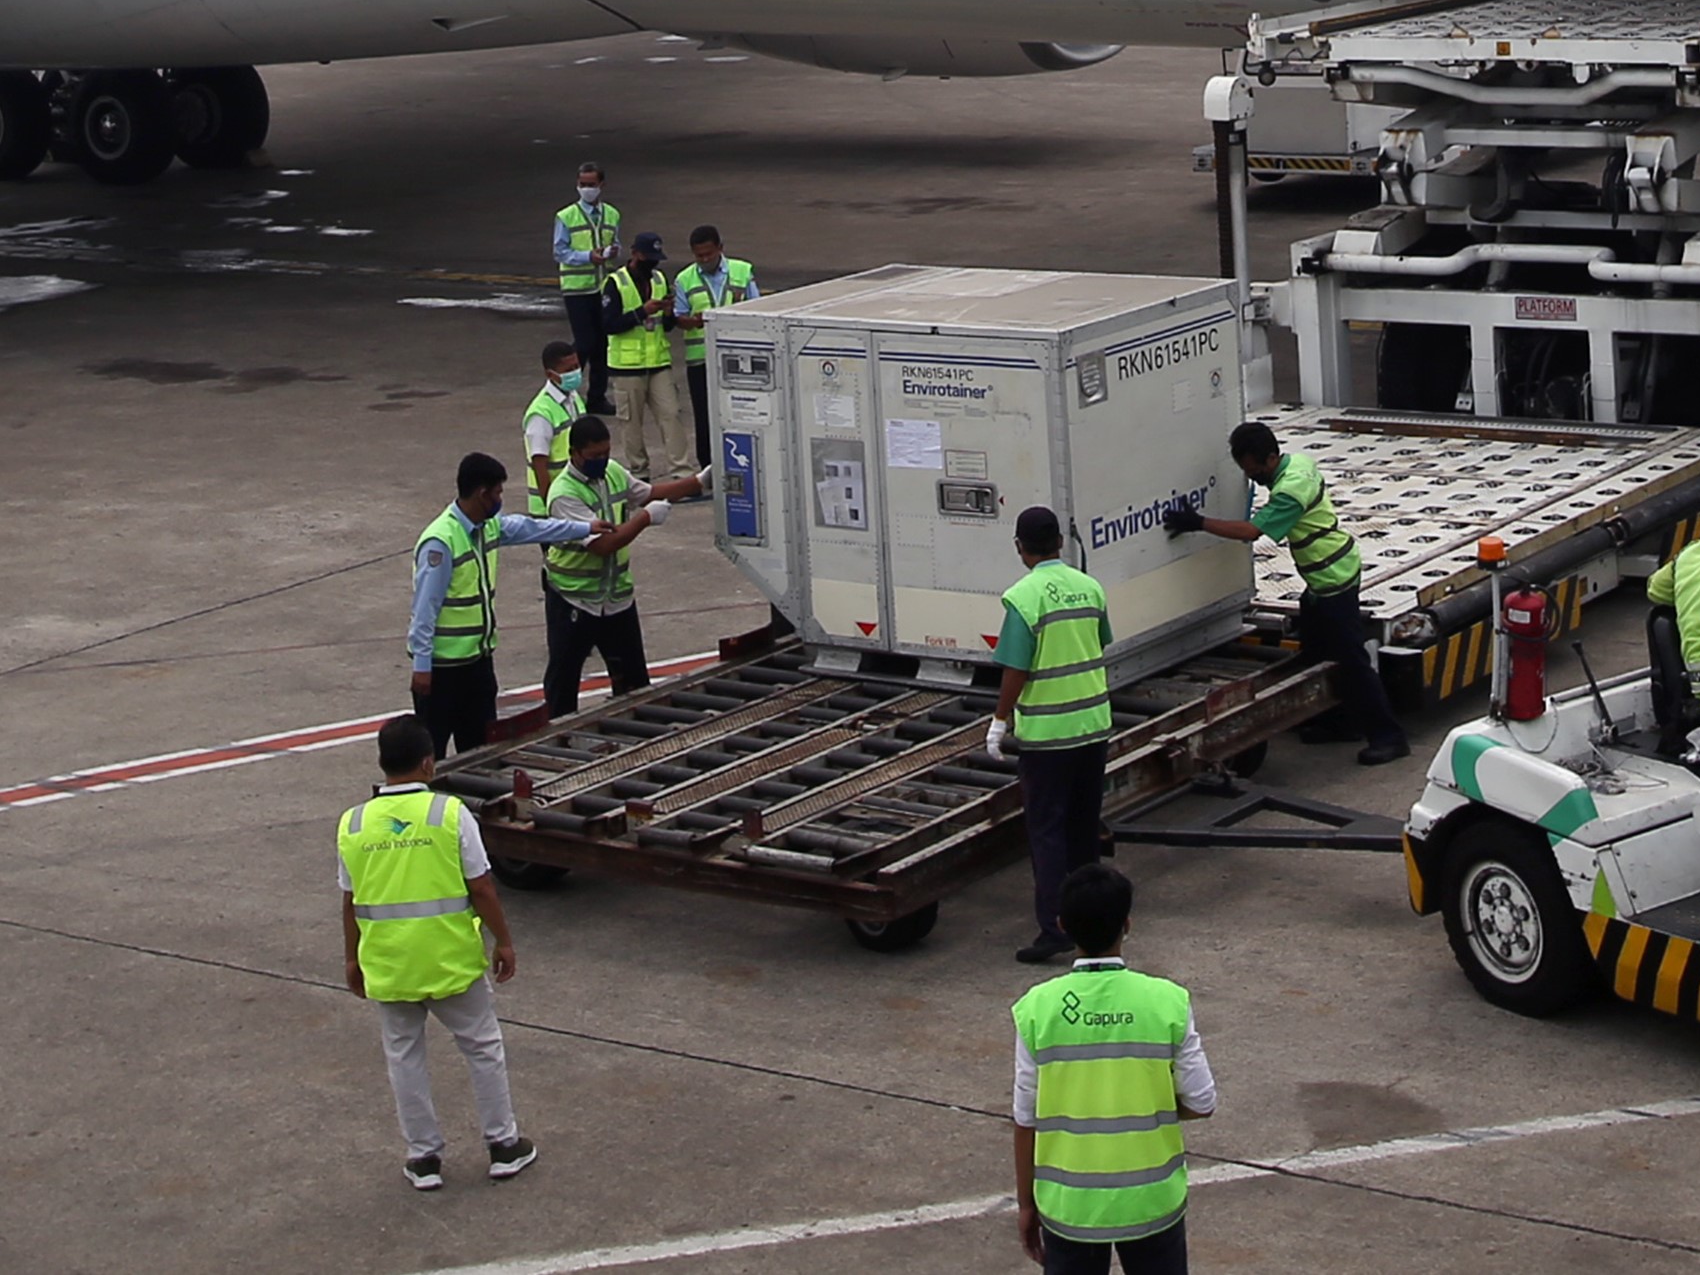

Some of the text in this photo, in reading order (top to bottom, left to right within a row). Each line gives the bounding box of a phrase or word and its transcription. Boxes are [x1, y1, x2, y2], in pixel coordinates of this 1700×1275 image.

[1518, 298, 1574, 314] PLATFORM
[1117, 328, 1220, 380] RKN61541PC
[902, 365, 974, 382] RKN61541PC
[902, 379, 988, 400] Envirotainer
[1083, 1011, 1135, 1028] Gapura
